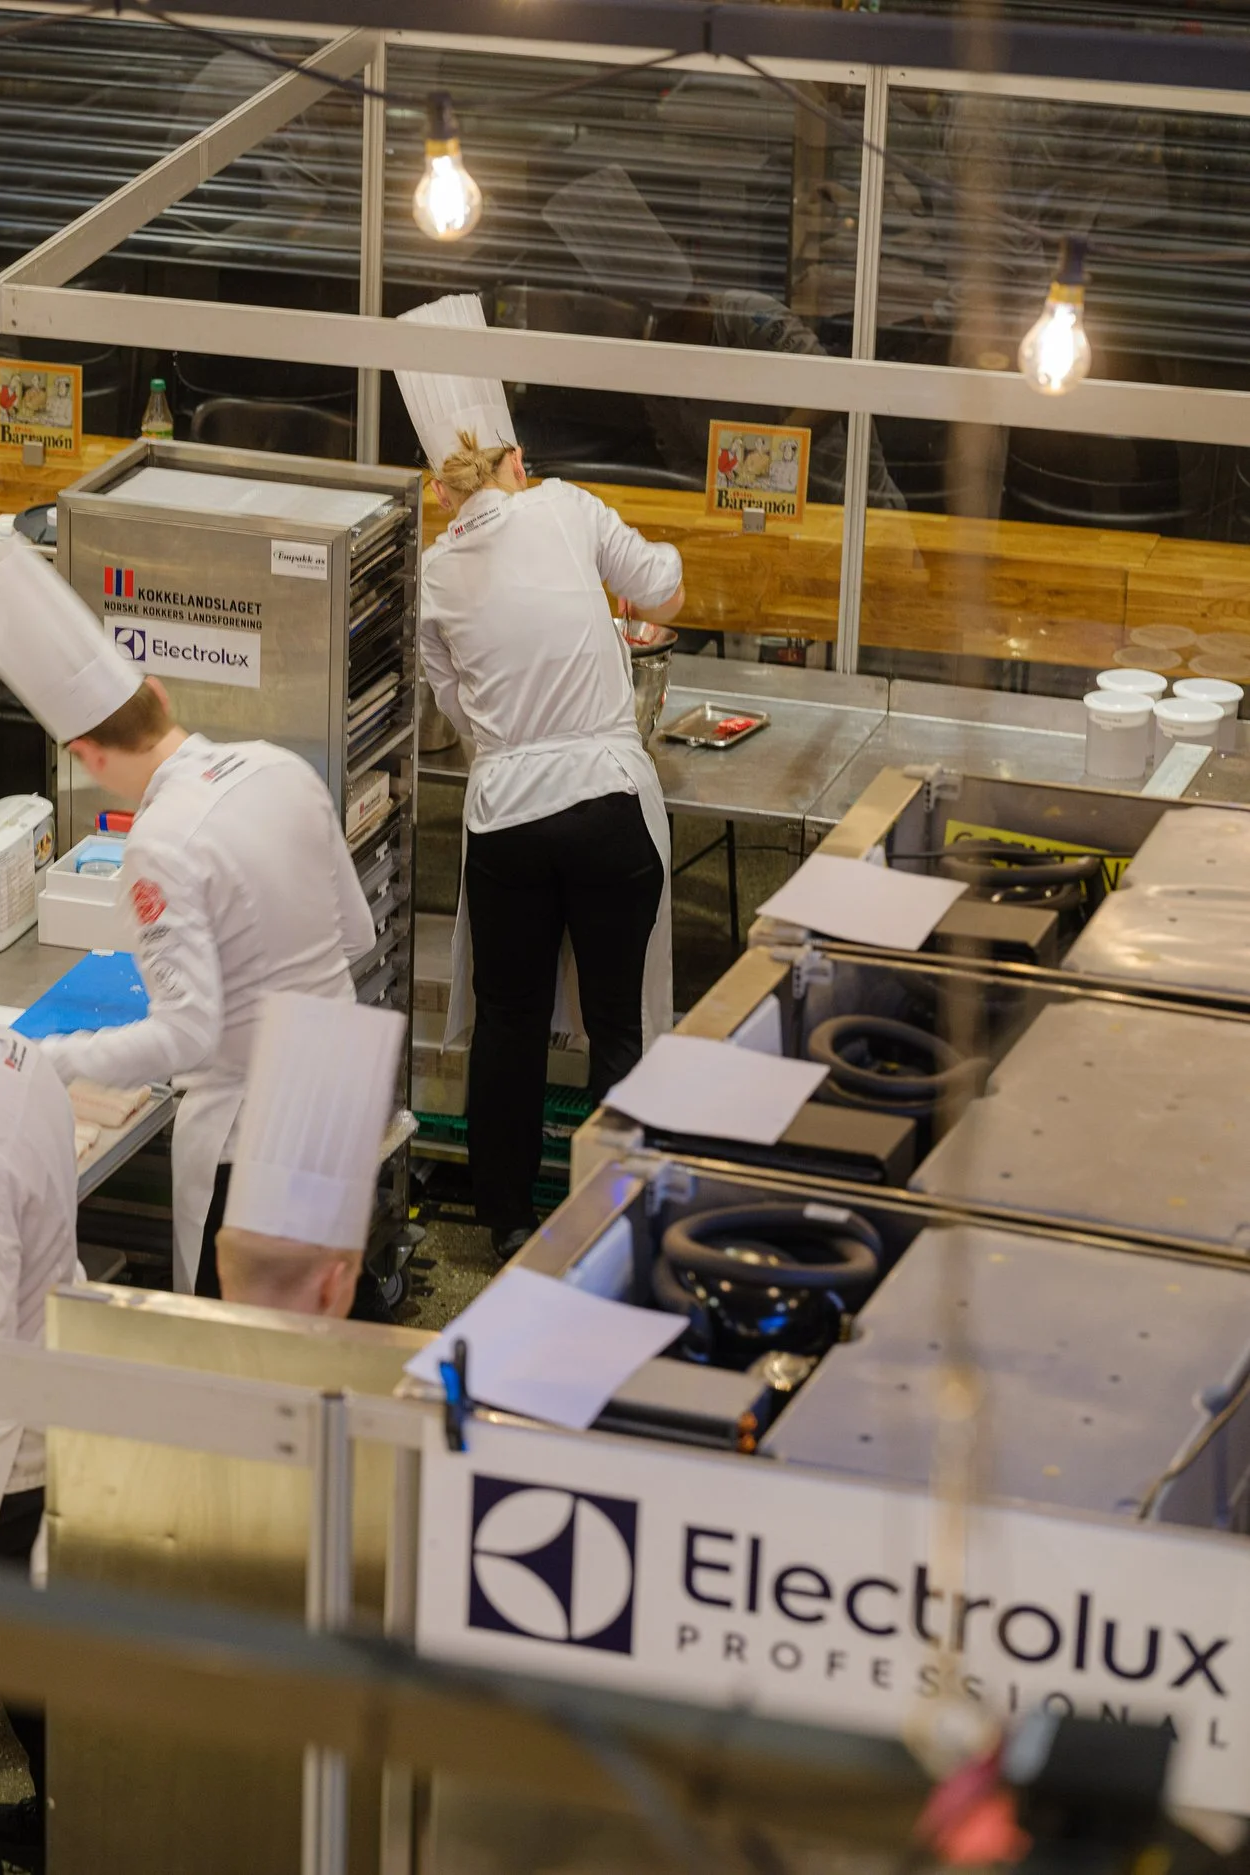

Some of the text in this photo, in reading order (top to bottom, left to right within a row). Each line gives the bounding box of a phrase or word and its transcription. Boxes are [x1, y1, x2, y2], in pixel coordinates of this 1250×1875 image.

[104, 600, 263, 630] NORSKE KOKKERS LANDSFORENING
[138, 588, 263, 616] KOKKELANDSLAGET
[152, 639, 249, 668] Electrolux
[682, 1525, 1231, 1697] Electrolux
